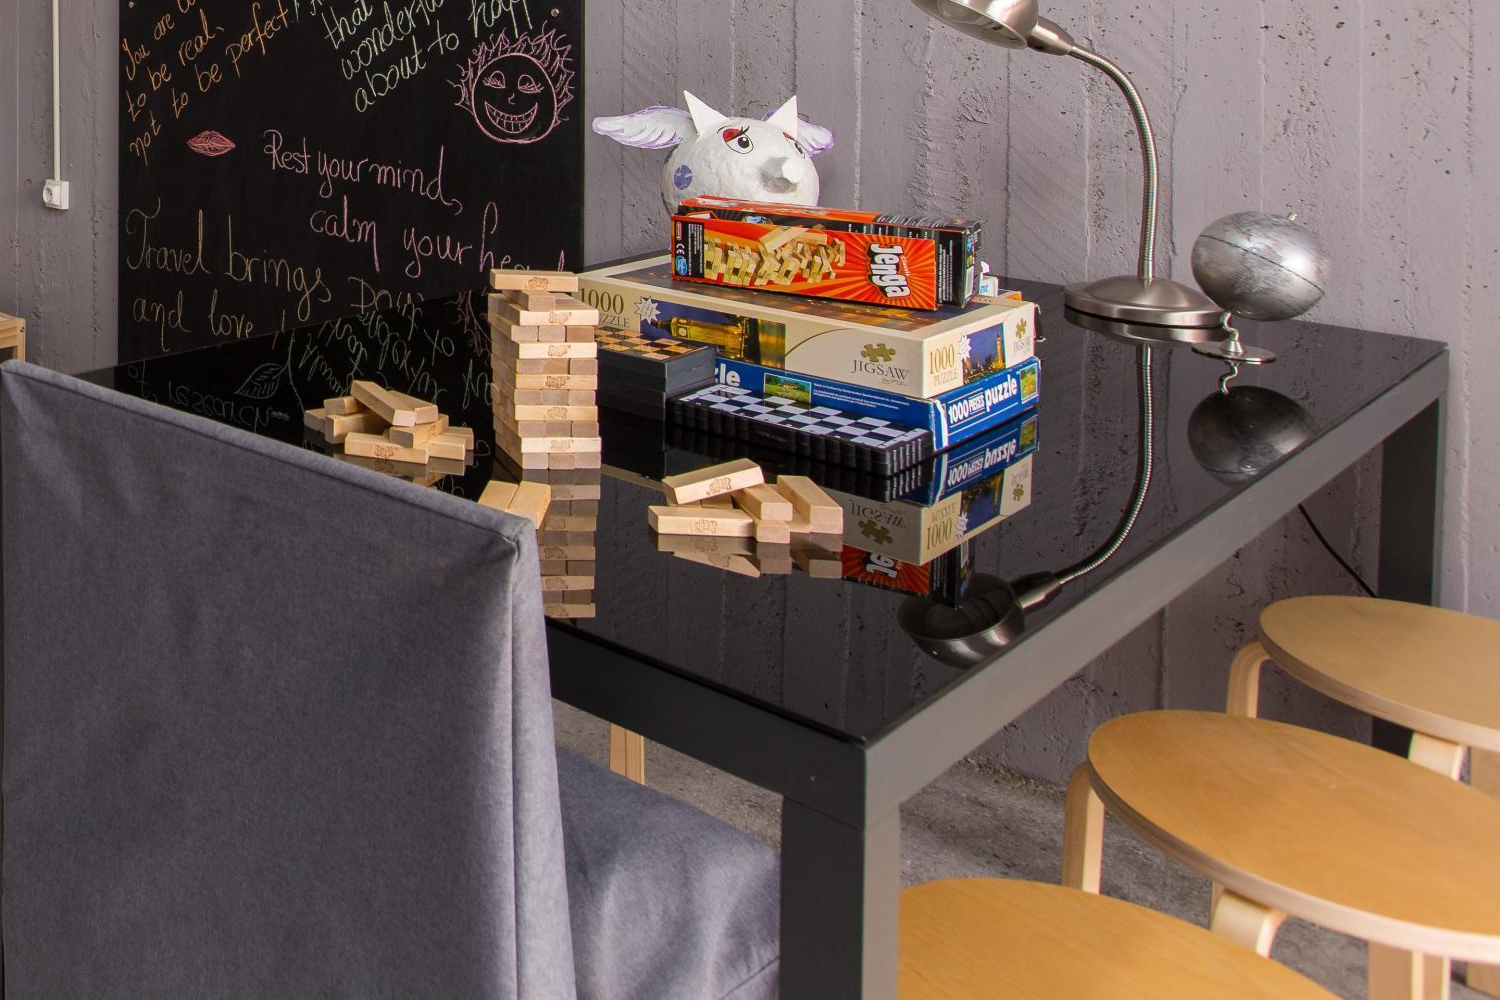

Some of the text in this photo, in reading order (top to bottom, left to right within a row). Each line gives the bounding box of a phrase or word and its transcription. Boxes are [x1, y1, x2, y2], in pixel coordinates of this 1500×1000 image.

[154, 12, 175, 41] are
[125, 90, 147, 122] to
[147, 63, 172, 91] be
[354, 35, 427, 113] about
[427, 19, 460, 55] to
[129, 109, 162, 167] not
[172, 87, 189, 119] to
[194, 62, 223, 93] be
[262, 129, 311, 176] Rest
[317, 150, 369, 199] your
[125, 196, 213, 275] Travel
[223, 213, 332, 322] brings
[309, 194, 380, 274] calm
[403, 227, 473, 279] your
[869, 243, 911, 298] Jenga
[132, 289, 193, 353] and
[207, 288, 254, 339] love
[579, 287, 625, 315] 1000
[602, 313, 631, 329] ZZLE
[851, 359, 909, 381] JIGSAW
[929, 343, 955, 374] 1000
[933, 370, 959, 387] PUZZLE
[948, 374, 1019, 424] 1000 PIECES puzzle
